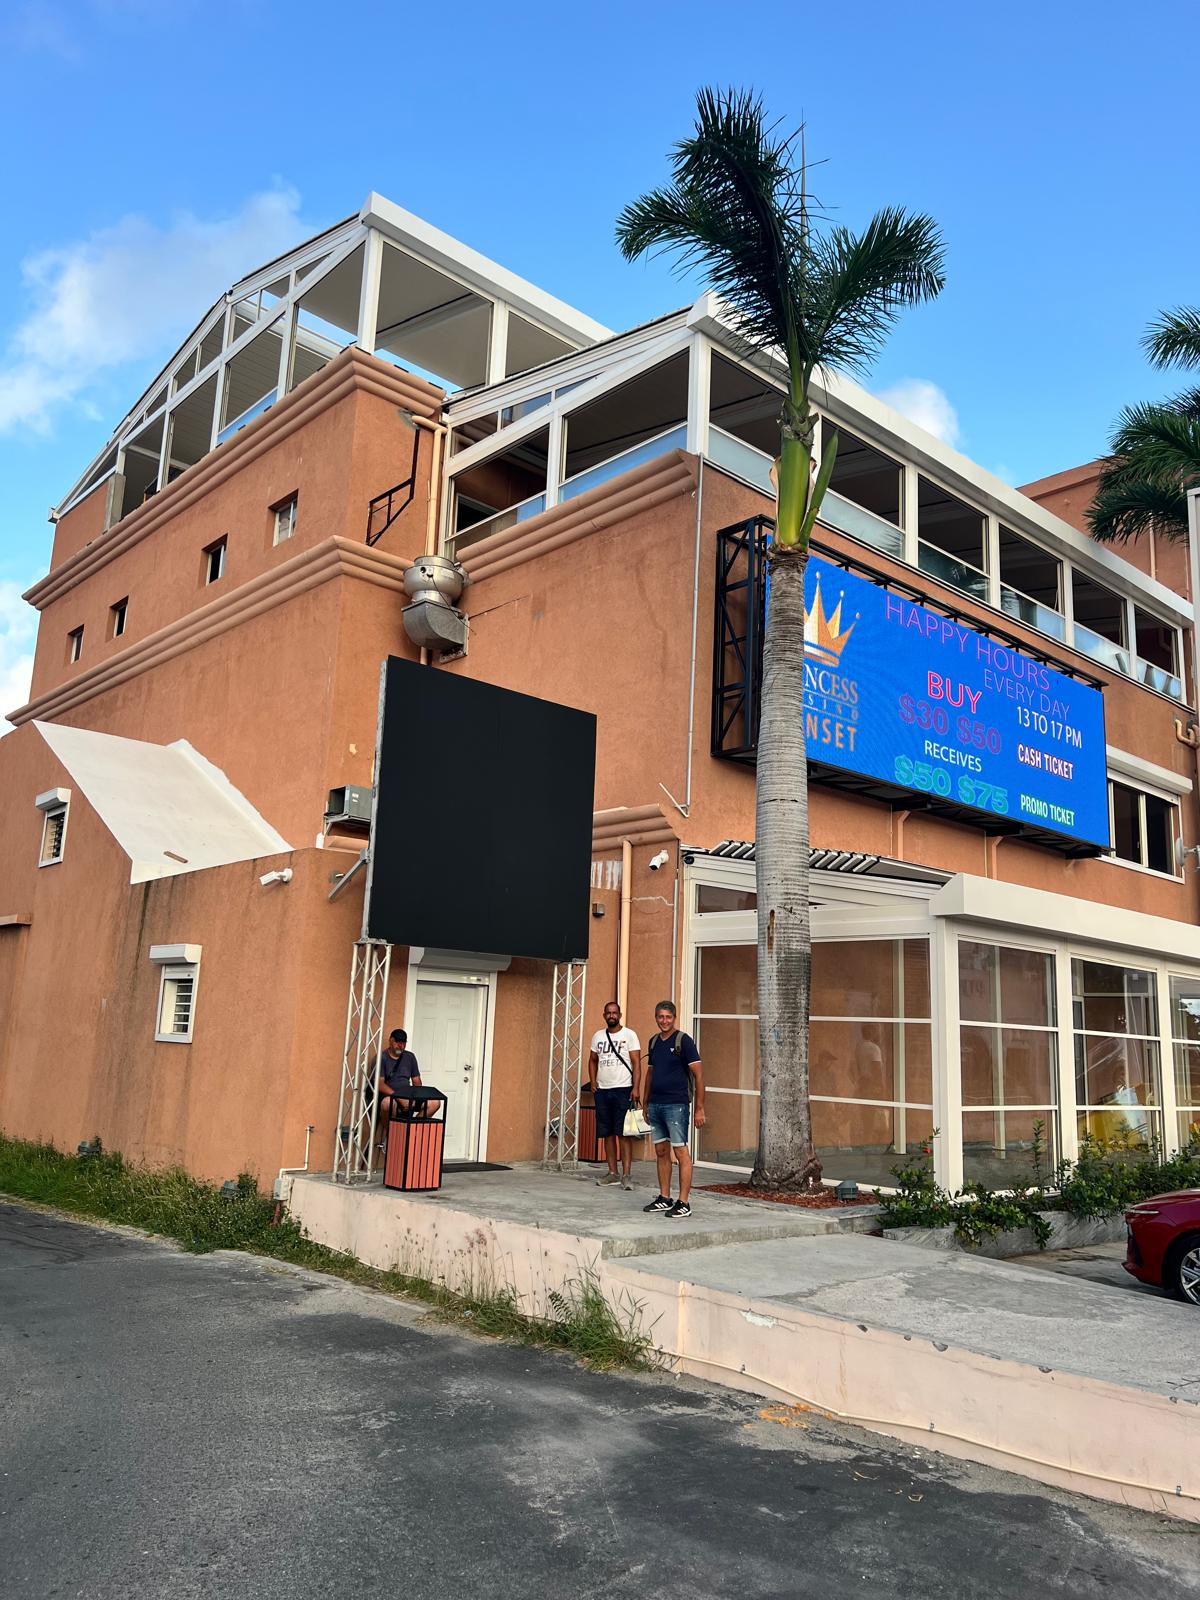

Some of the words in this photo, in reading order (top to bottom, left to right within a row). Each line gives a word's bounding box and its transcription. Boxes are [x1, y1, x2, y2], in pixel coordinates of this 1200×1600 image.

[886, 595, 969, 653] HAPPY
[976, 637, 1050, 690] HOURS
[803, 663, 859, 704] NCESS
[927, 671, 982, 714] BUY
[984, 668, 1035, 706] EVERY
[1040, 693, 1070, 721] DAY
[806, 712, 857, 753] NSET
[899, 693, 950, 736] $30
[956, 714, 1001, 755] $50
[1017, 706, 1030, 728] 13
[1032, 711, 1048, 735] TO
[1051, 720, 1063, 740] 17
[1066, 726, 1082, 749] PM
[924, 739, 982, 773] RECEIVES
[1018, 743, 1042, 768] CASH
[1044, 751, 1074, 780] TICKET
[894, 754, 951, 796] $50
[957, 774, 1009, 815] $75
[1020, 793, 1048, 818] PROMO
[1049, 804, 1075, 826] TICKET
